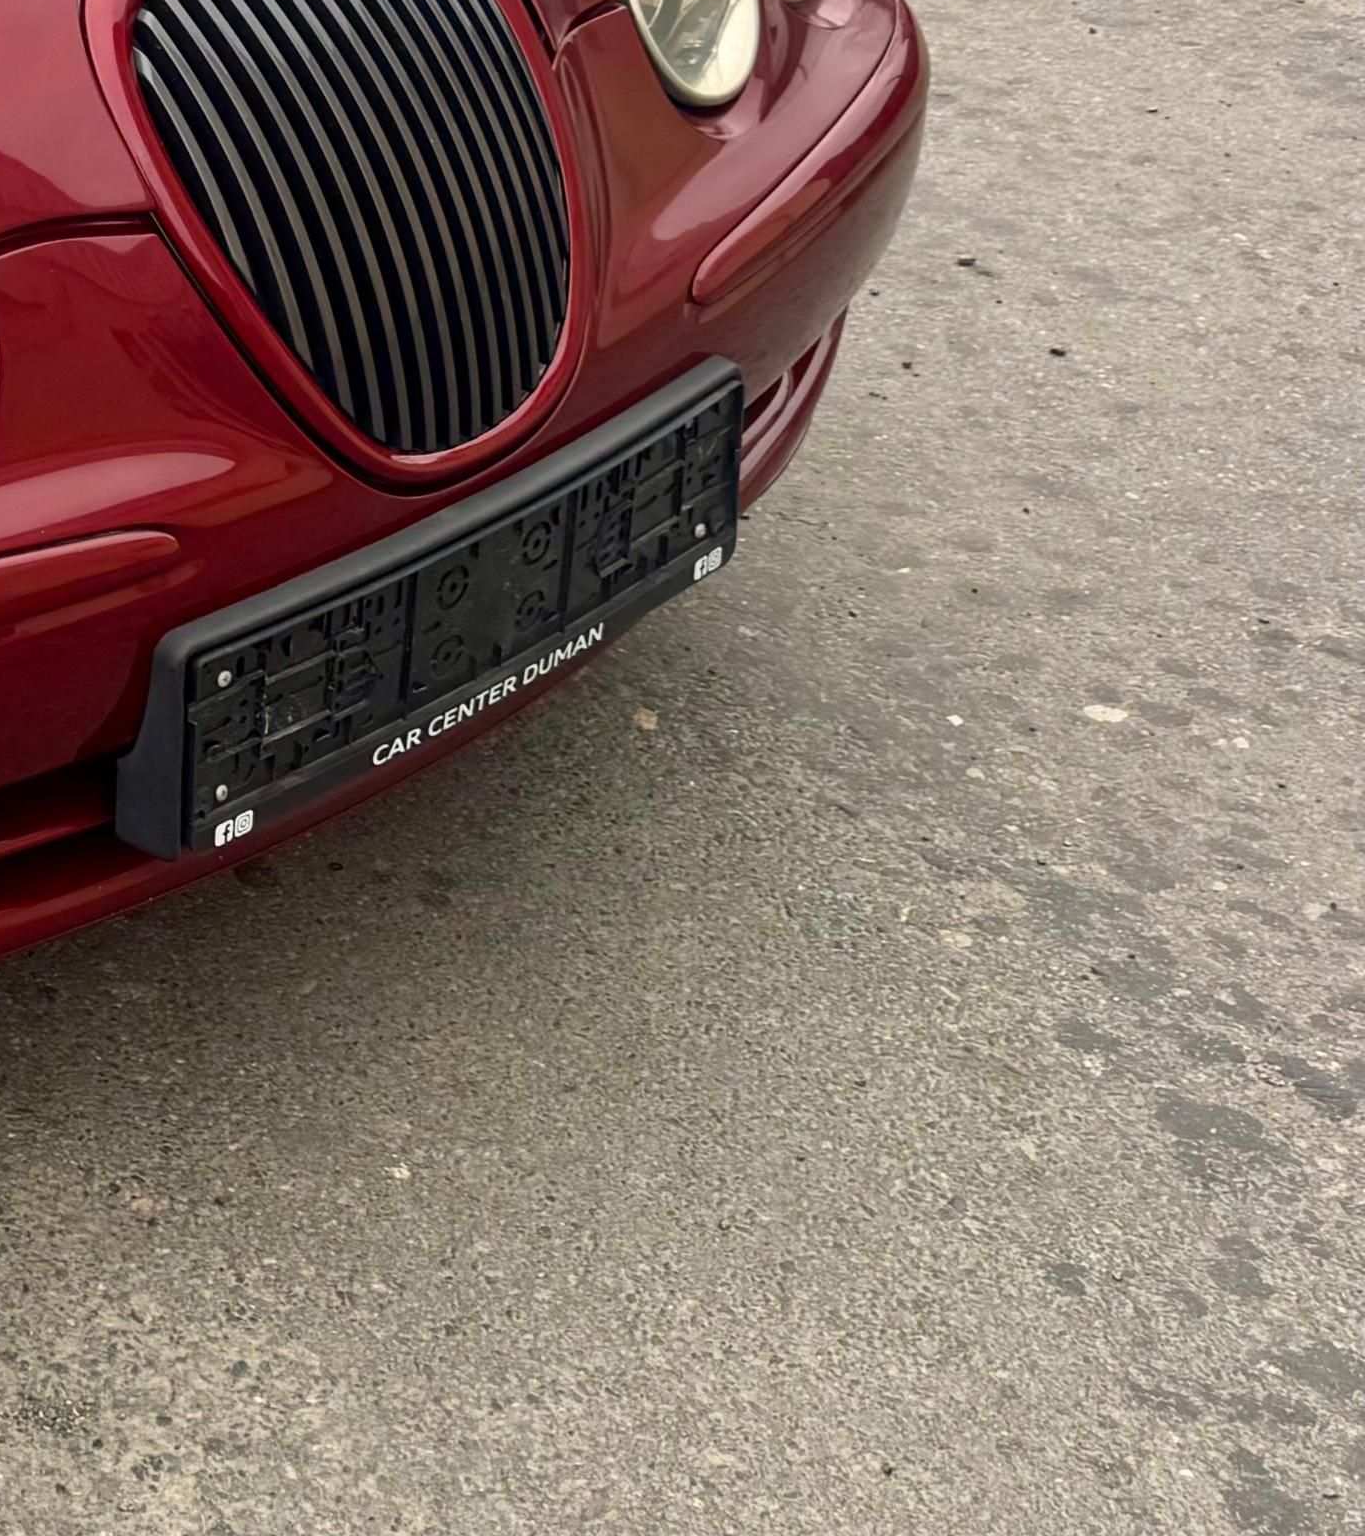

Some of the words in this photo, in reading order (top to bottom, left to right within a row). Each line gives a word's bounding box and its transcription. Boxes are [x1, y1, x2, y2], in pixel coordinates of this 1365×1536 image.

[371, 728, 422, 766] CAR
[427, 675, 518, 737] CENTER
[521, 621, 605, 686] DUMAN
